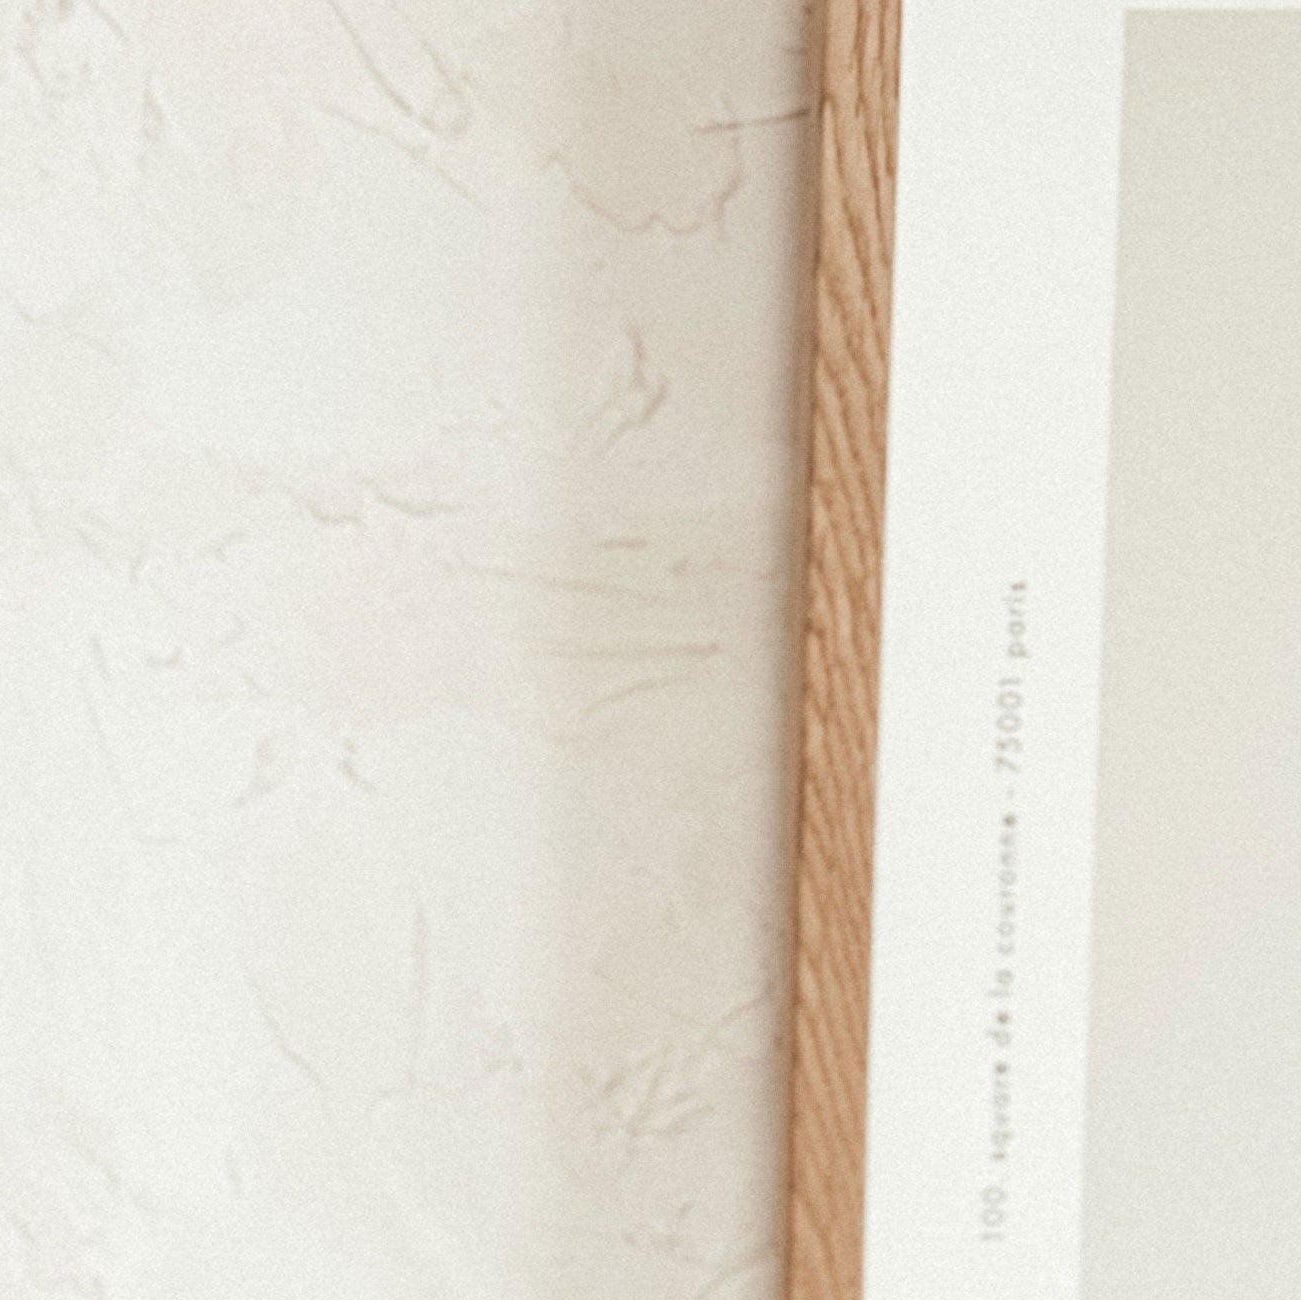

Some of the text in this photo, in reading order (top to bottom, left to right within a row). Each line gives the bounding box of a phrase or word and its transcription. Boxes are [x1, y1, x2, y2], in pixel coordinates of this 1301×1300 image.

[1005, 581, 1029, 658] paris
[994, 678, 1022, 772] 75001
[988, 969, 1013, 997] la
[986, 1011, 1011, 1046] de
